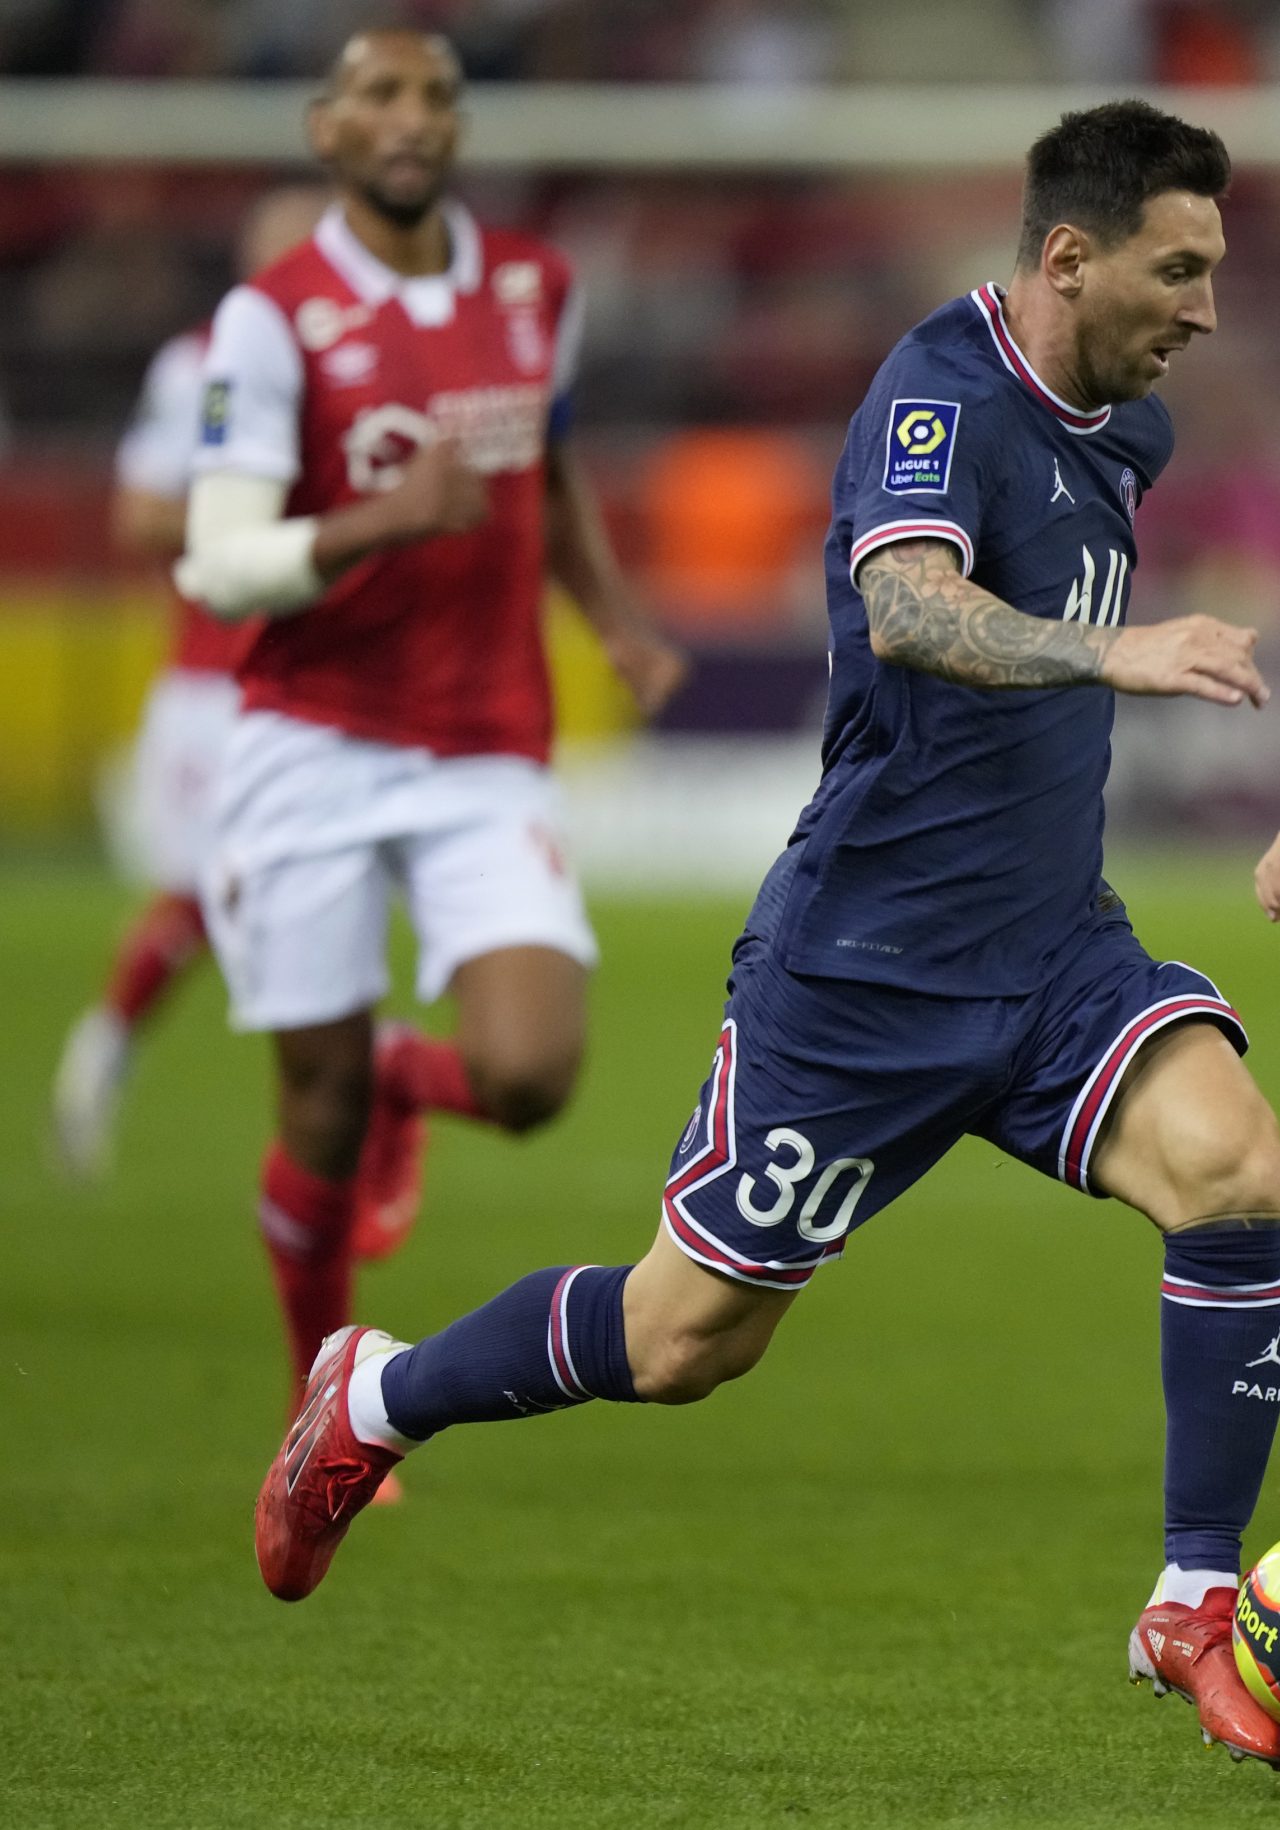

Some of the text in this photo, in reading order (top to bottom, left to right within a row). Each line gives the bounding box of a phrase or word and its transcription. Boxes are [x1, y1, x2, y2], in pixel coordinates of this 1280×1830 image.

[895, 459, 939, 471] LIGUE 1
[891, 471, 940, 484] Uber Eats
[735, 1127, 875, 1243] 30
